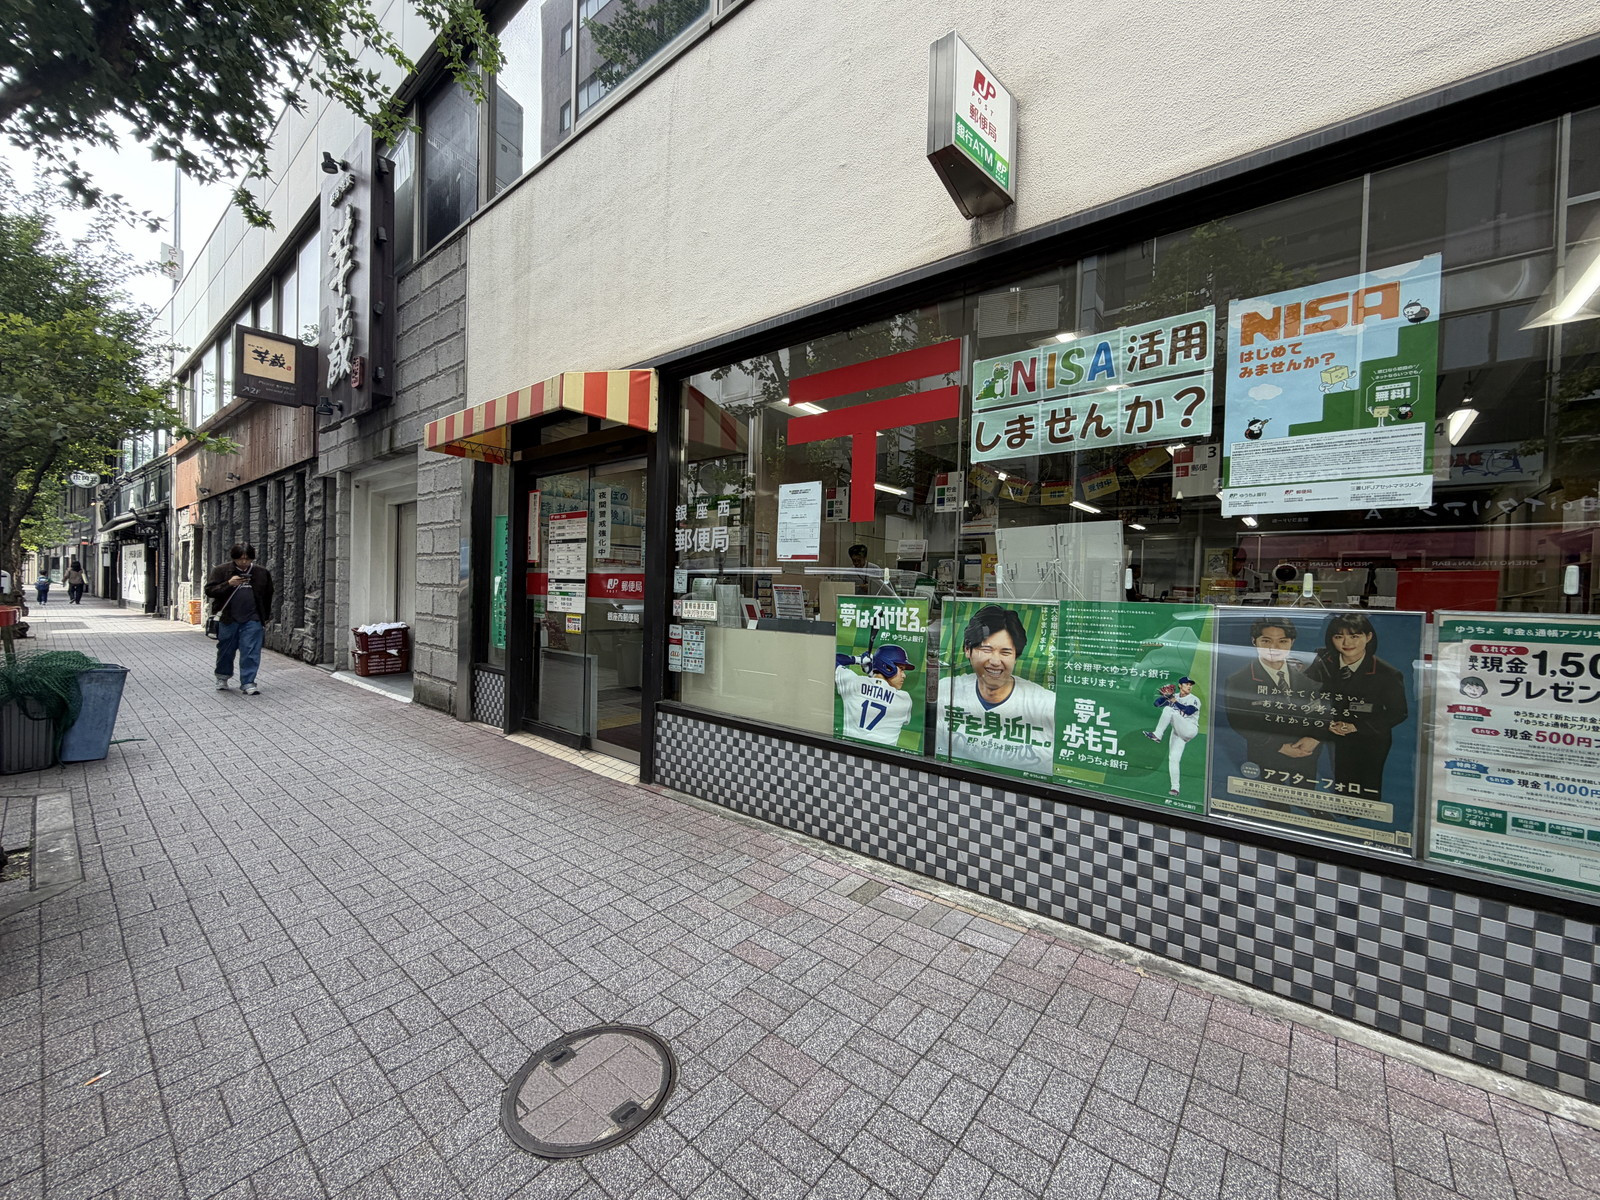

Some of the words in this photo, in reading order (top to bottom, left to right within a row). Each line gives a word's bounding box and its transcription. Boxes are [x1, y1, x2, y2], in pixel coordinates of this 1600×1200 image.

[971, 91, 994, 116] POST
[969, 102, 997, 143] 郵便局
[956, 121, 994, 167] 銀行ATM
[1239, 280, 1401, 346] NISA
[1239, 342, 1304, 364] はじめて
[1238, 351, 1336, 379] みませんか？
[974, 385, 1206, 453] しませんか？
[1434, 422, 1446, 436] 4
[1207, 446, 1216, 458] 3
[1191, 463, 1207, 471] 郵便
[1088, 478, 1112, 492] 受付中
[675, 500, 730, 521] 銀座西
[598, 491, 606, 556] 夜間警戒強化中
[674, 526, 729, 552] 郵便局
[621, 580, 643, 593] 郵便局
[607, 611, 640, 624] 銀座西郵便局
[892, 633, 924, 643] ゆうちょ銀行
[1455, 625, 1495, 635] ゆうちょ
[1481, 646, 1517, 654] もれなく
[1064, 661, 1170, 680] 大谷翔平×ゆうちょ銀行
[1469, 655, 1478, 671] 最大
[1064, 674, 1120, 689] はじまります。
[861, 683, 895, 704] OHTANI
[859, 699, 887, 731] 17
[1074, 698, 1111, 727] 夢と
[1264, 713, 1349, 732] これからのこと
[944, 705, 1052, 748] 夢を身近に。
[980, 741, 1018, 753] ゆうちょ銀行
[1062, 723, 1126, 756] 歩もう。
[1078, 753, 1129, 771] ゆうちょ銀行
[1263, 768, 1380, 793] アフターフォロー
[1465, 807, 1503, 818] ゆうちょ通帳
[1465, 813, 1490, 821] アプリで
[1435, 845, 1555, 873] https://www.jp-bank.japanpost.jp/
